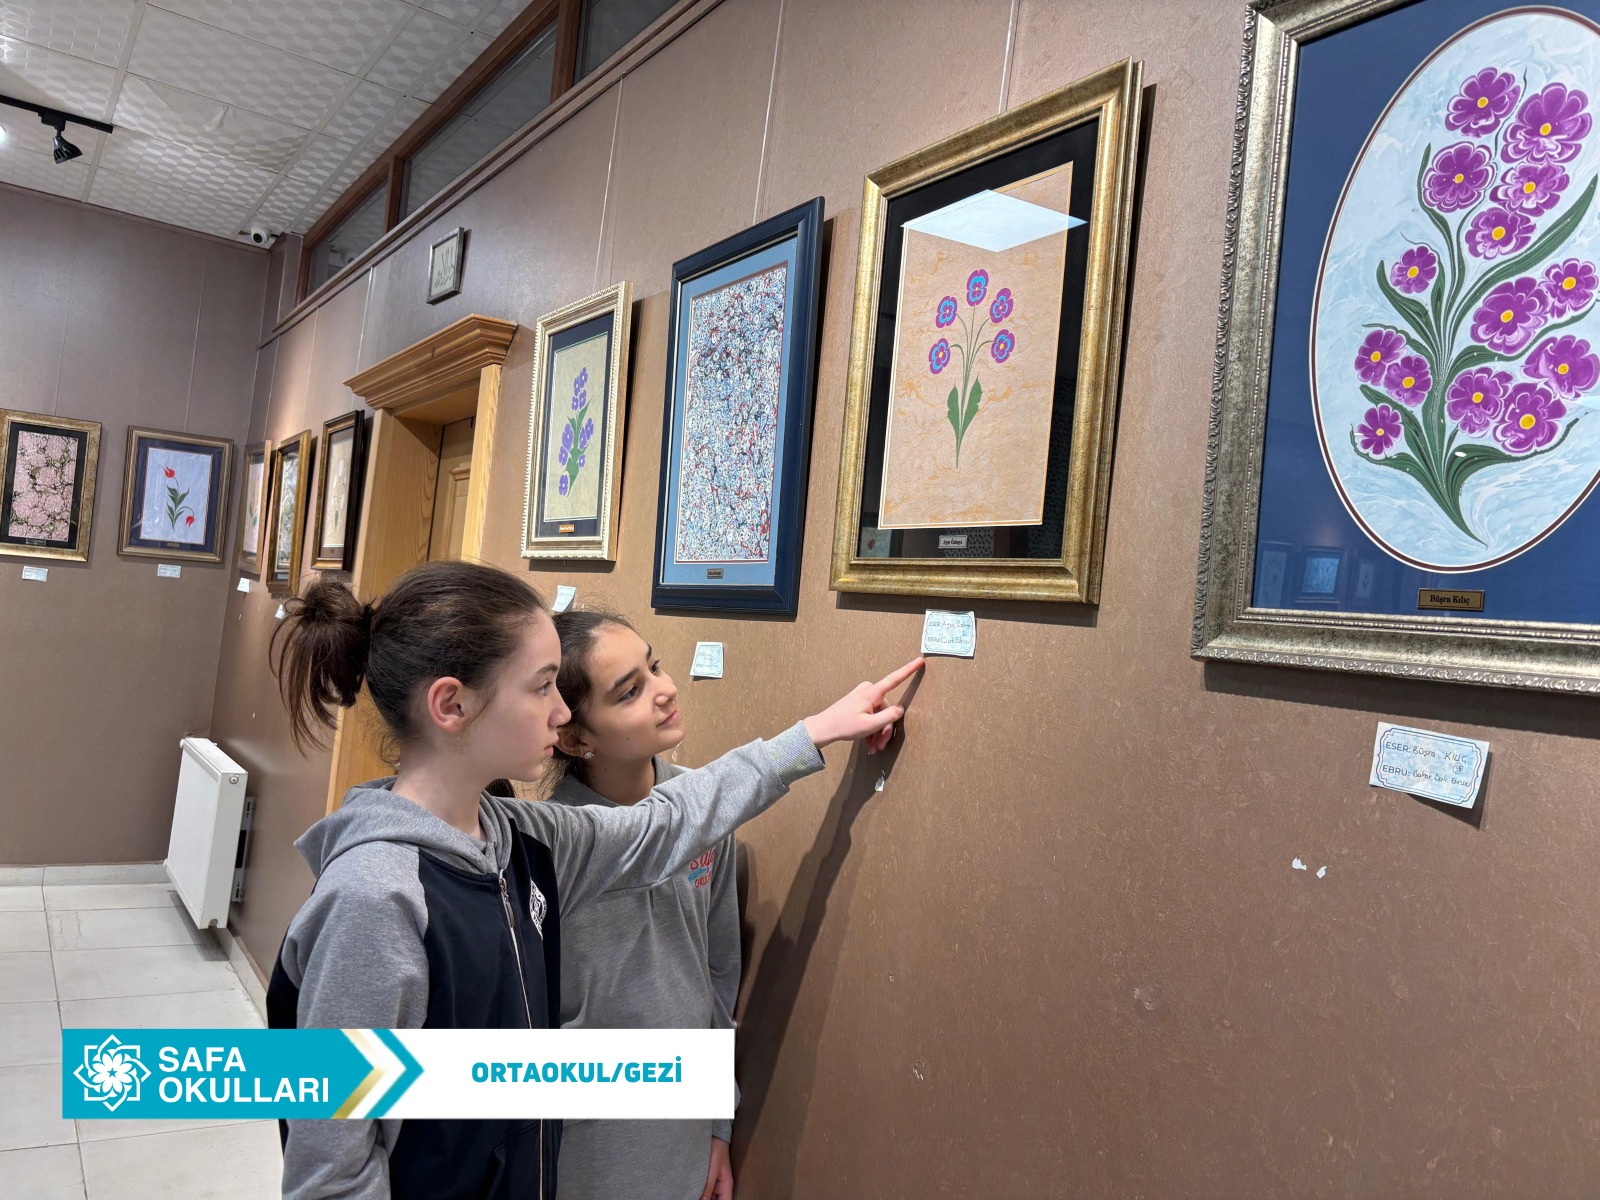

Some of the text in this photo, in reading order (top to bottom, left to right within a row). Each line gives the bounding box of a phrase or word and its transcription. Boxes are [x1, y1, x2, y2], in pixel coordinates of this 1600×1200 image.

[1430, 595, 1470, 605] Büşra Kılıç
[1385, 741, 1411, 753] ESER:
[1412, 745, 1436, 758] Büşra
[1382, 764, 1410, 777] EBRU:
